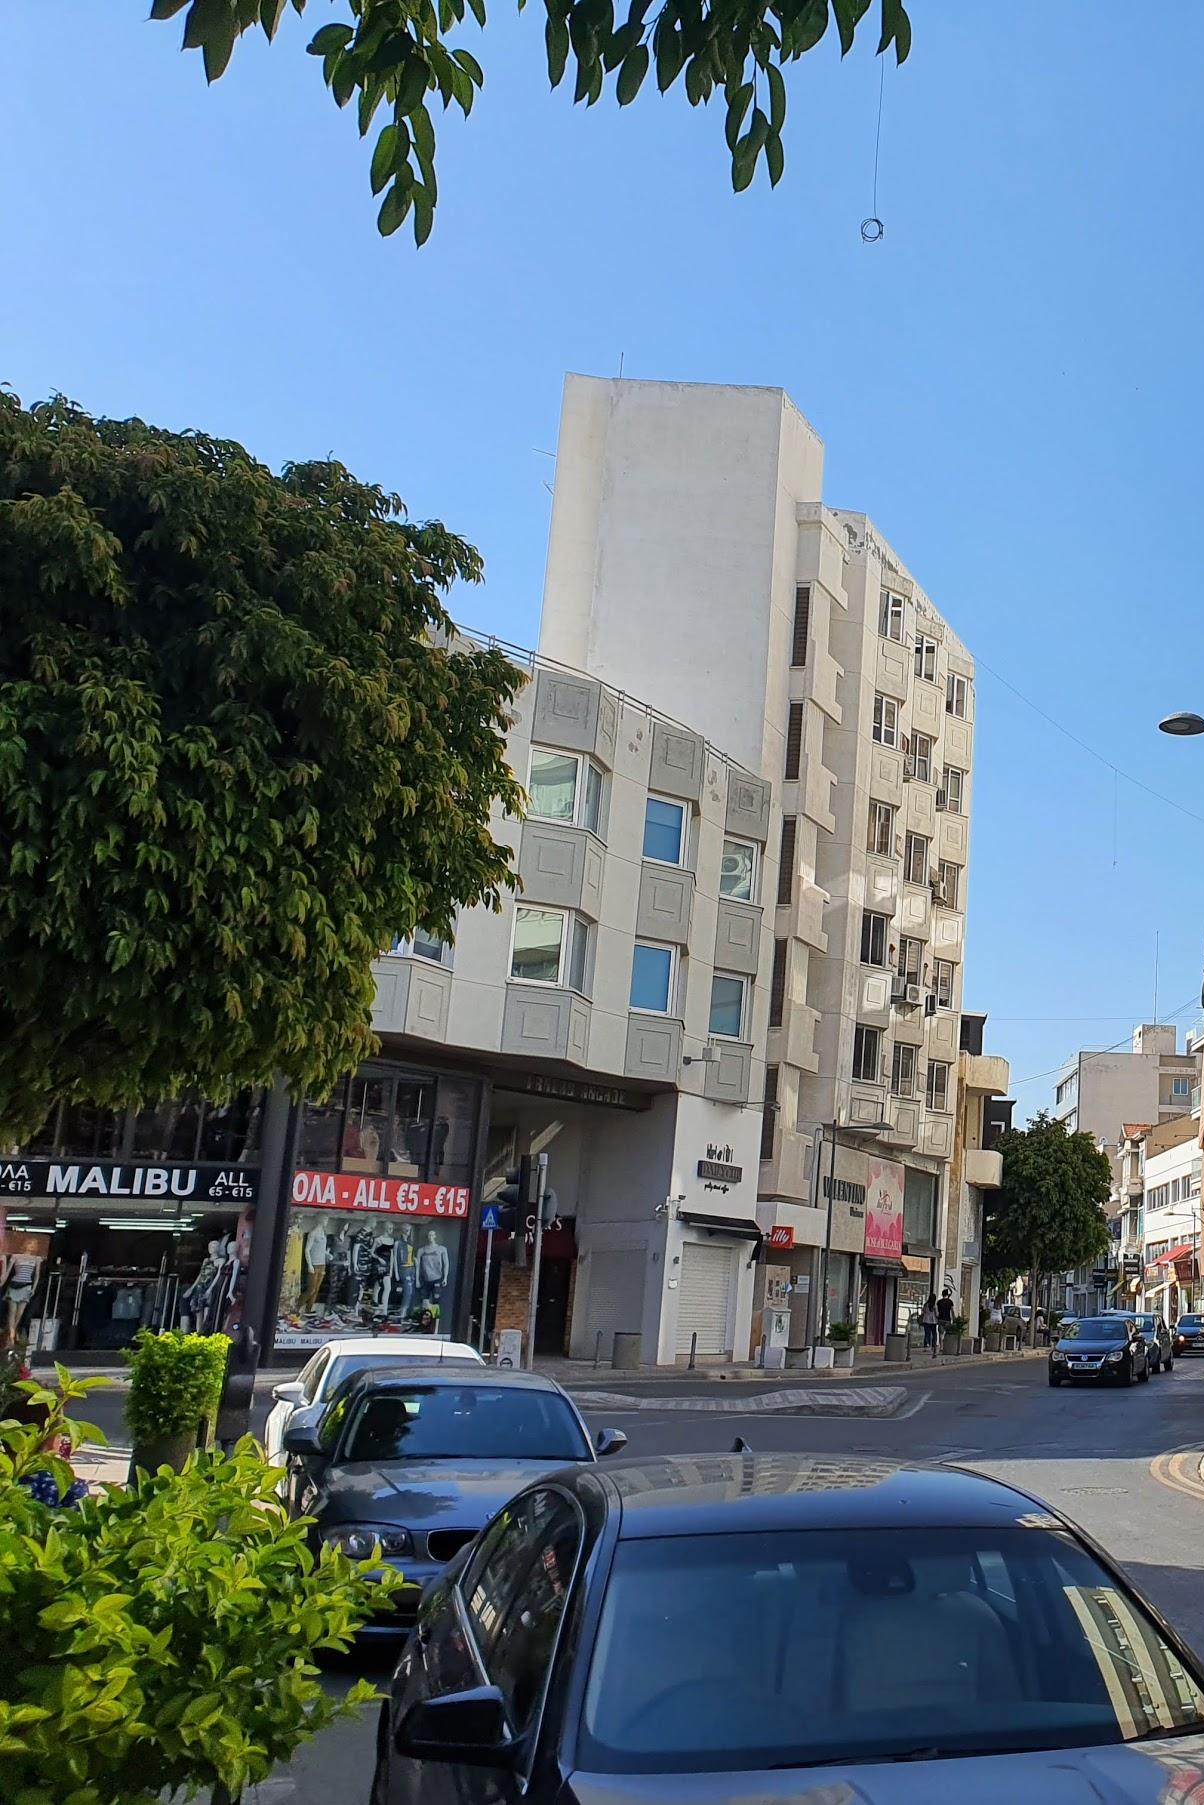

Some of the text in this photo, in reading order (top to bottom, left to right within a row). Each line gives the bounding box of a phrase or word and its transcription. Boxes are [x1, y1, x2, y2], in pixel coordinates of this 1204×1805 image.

[8, 1180, 32, 1191] €15
[46, 1165, 197, 1196] MALIBU
[214, 1171, 249, 1187] ALL
[208, 1186, 223, 1197] €5
[231, 1186, 253, 1198] €15
[292, 1173, 336, 1204] ΟΛΑ
[353, 1179, 390, 1208] ALL
[396, 1183, 419, 1211] €5
[434, 1186, 467, 1215] €15
[823, 1175, 866, 1205] VLENTINO
[772, 1229, 789, 1245] illy
